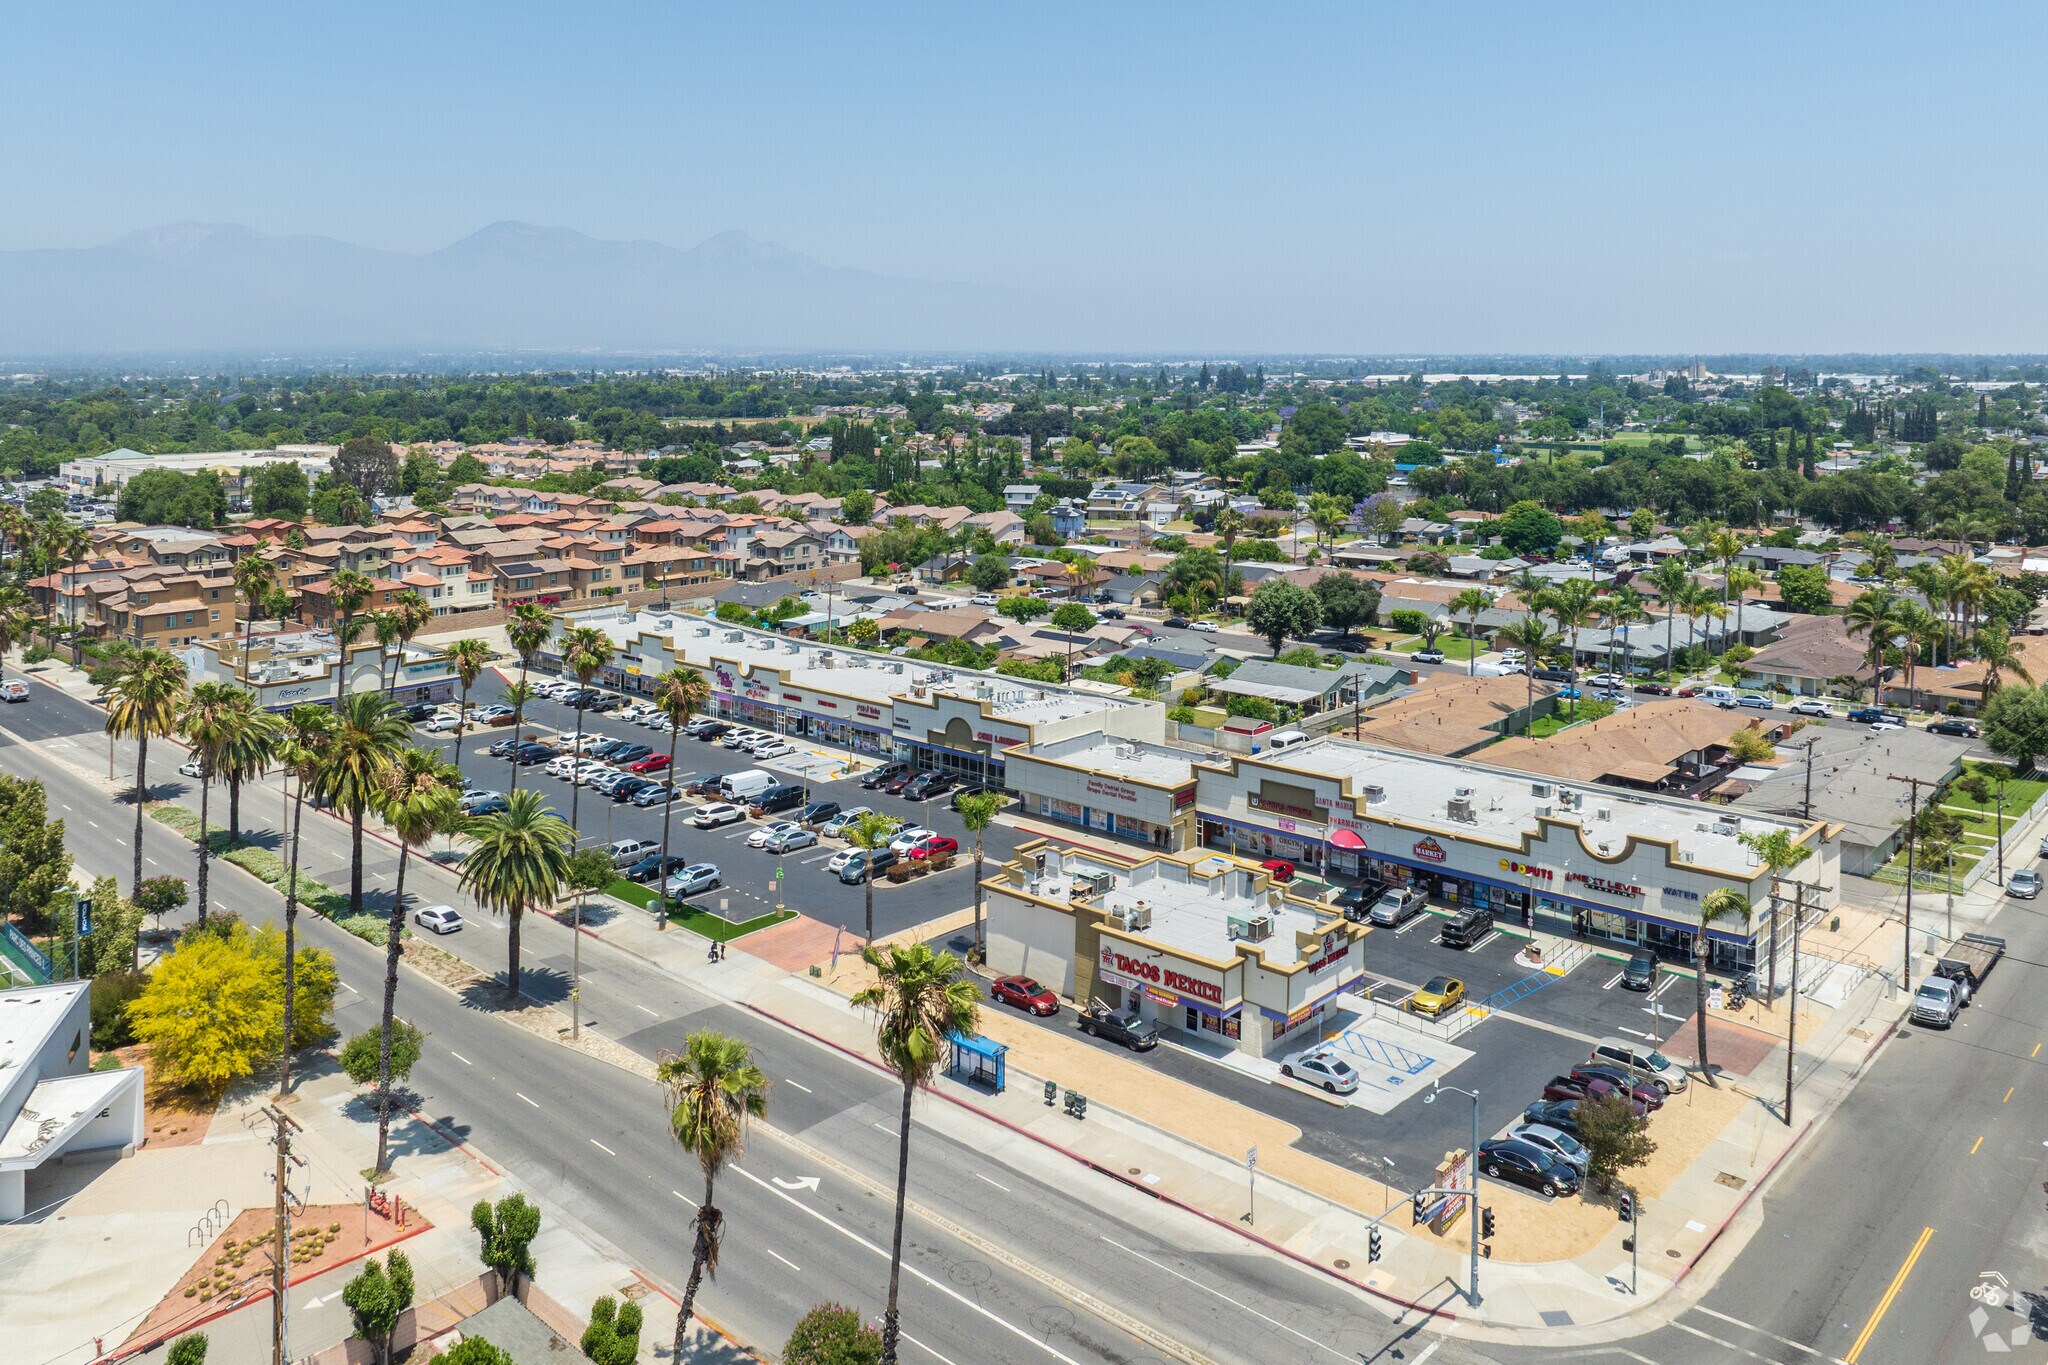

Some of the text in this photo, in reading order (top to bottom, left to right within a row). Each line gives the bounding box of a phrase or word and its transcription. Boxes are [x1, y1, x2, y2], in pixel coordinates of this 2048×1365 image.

[1086, 786, 1101, 794] Grupo
[1102, 789, 1117, 797] Dental
[1087, 780, 1136, 796] Family Dental Group
[1315, 796, 1354, 811] SANTA MARIA
[1329, 816, 1363, 830] PHARMACY
[1278, 836, 1300, 848] OBGYN
[1415, 847, 1443, 859] MARKET
[1510, 861, 1554, 881] DONUTS
[1572, 872, 1646, 896] NEXT LEVEL
[1584, 884, 1635, 898] STAFFING
[1662, 887, 1699, 901] WATER
[1115, 953, 1223, 1004] TACOS MEXICO
[1445, 1200, 1464, 1219] WATER
